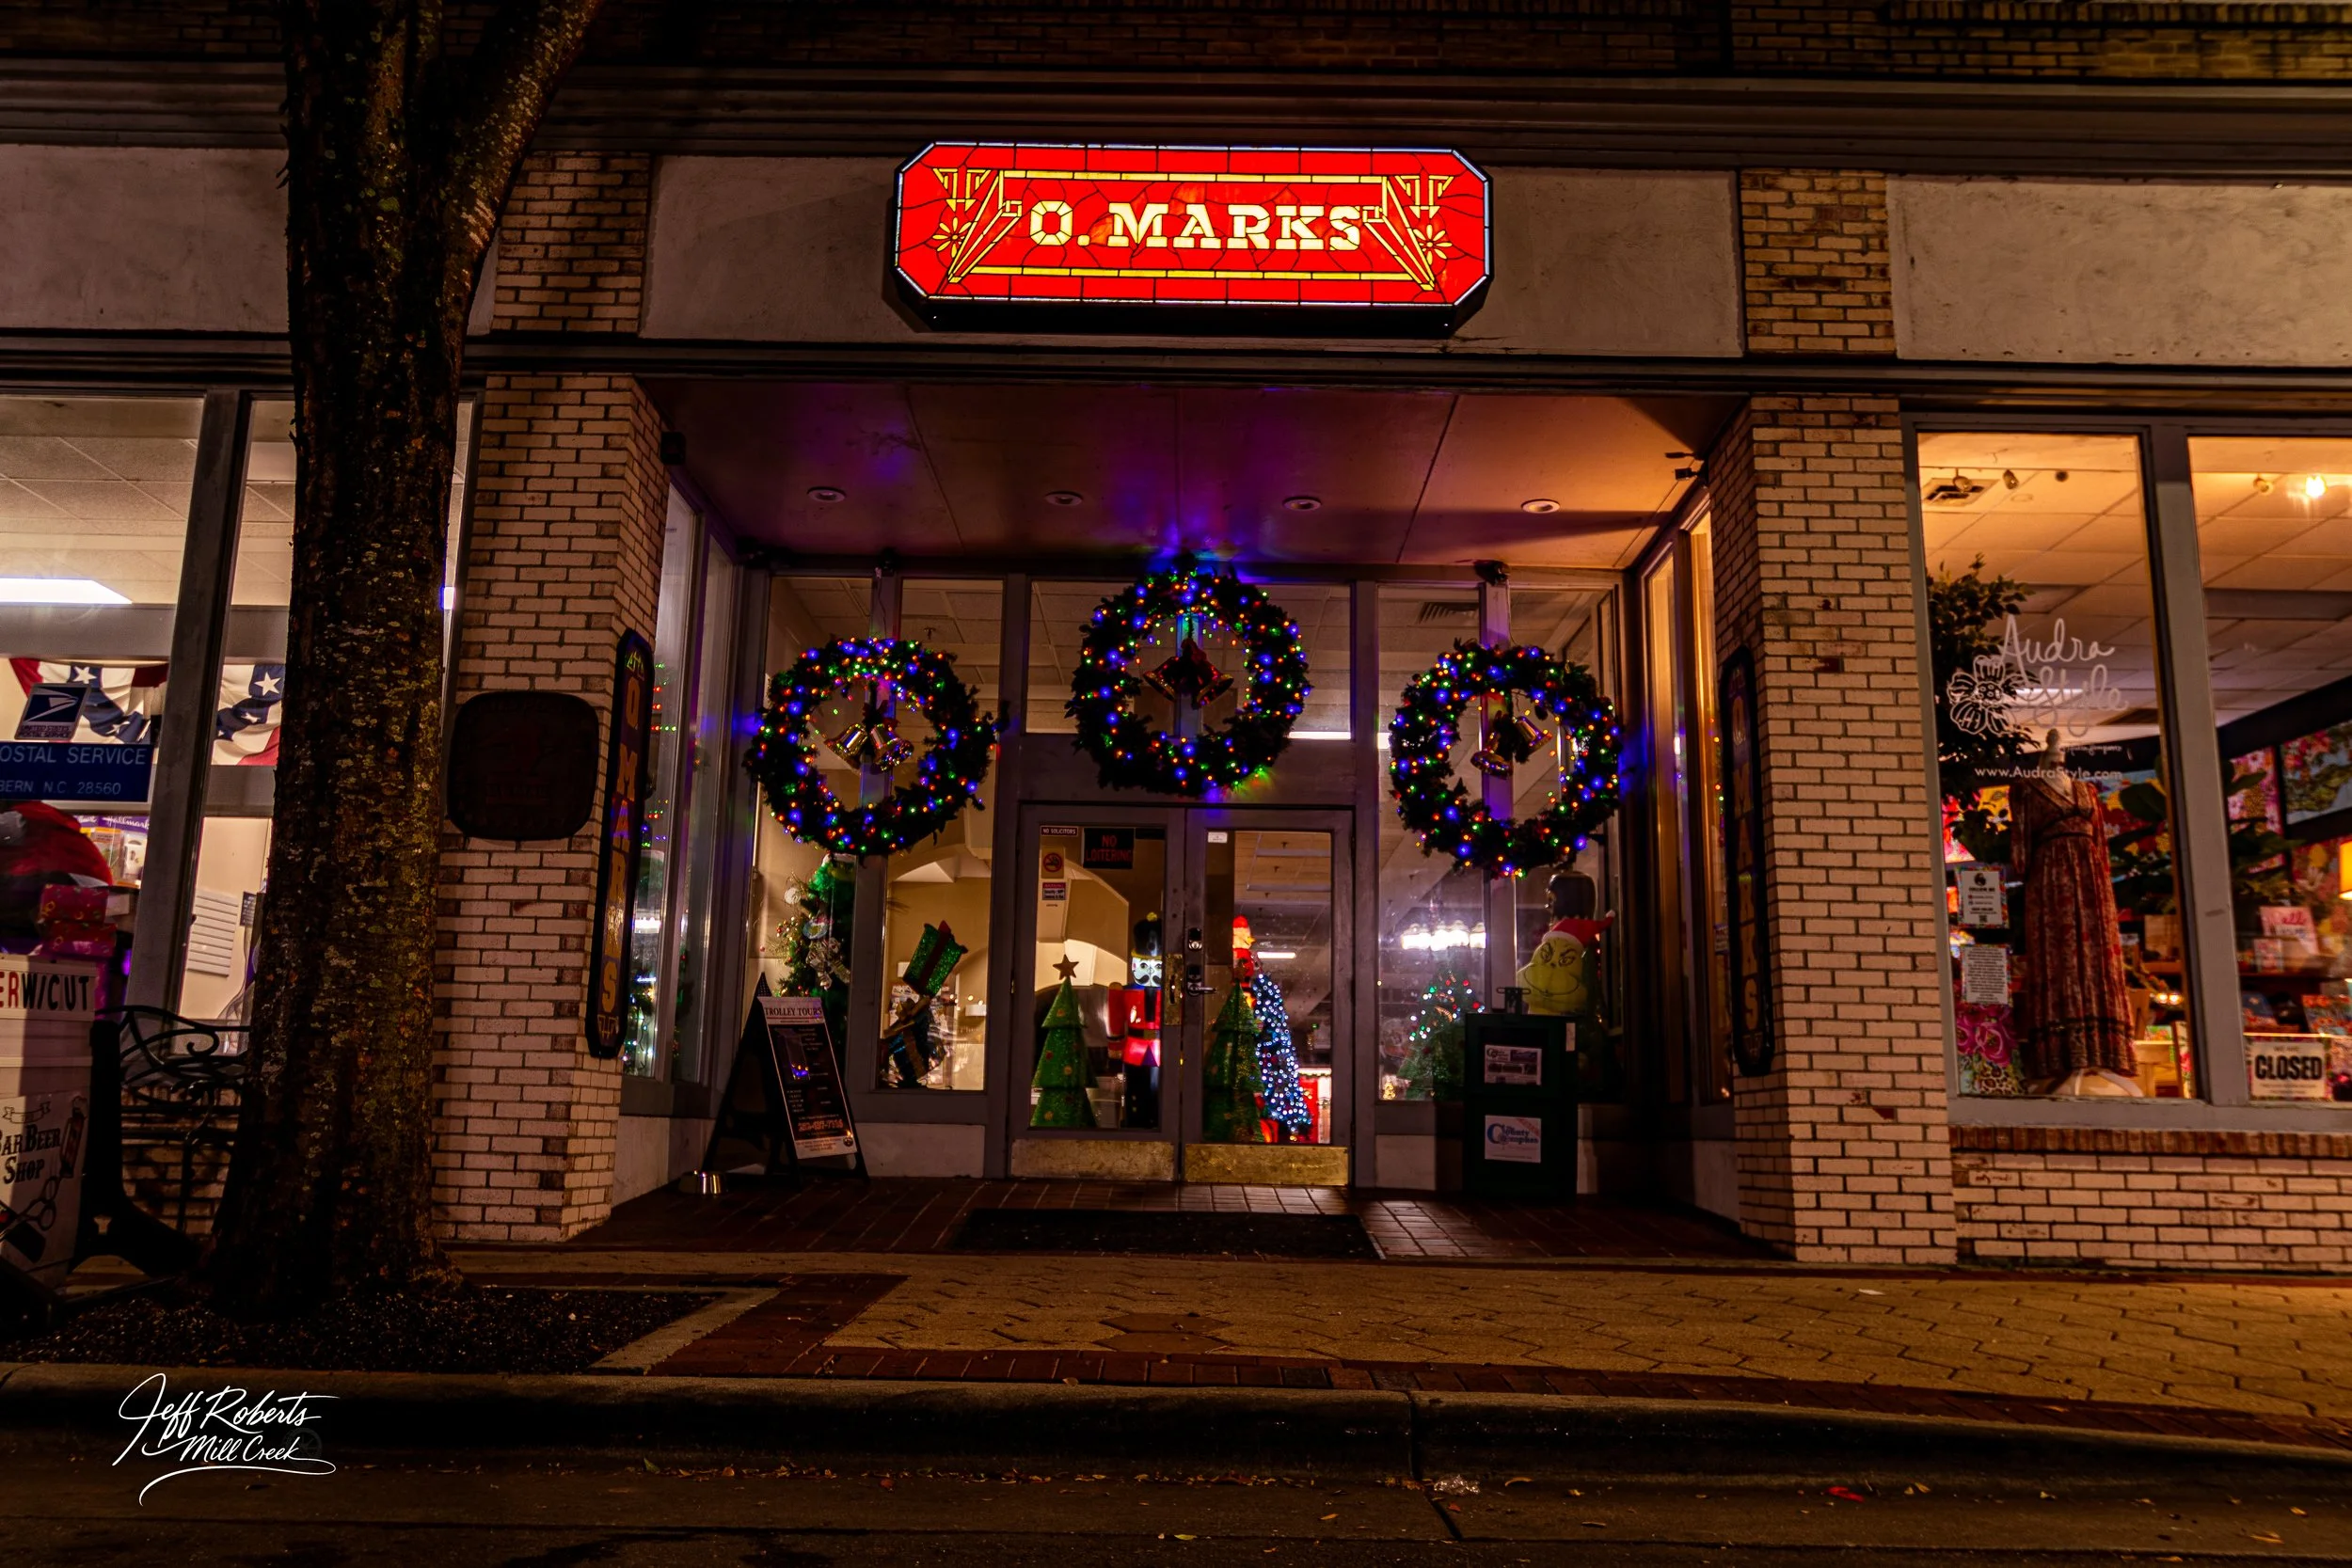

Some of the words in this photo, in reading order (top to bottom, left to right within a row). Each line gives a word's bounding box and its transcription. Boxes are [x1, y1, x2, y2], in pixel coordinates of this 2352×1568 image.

[1029, 200, 1090, 246] O.
[1107, 202, 1362, 251] MARKS
[1996, 614, 2115, 679] Audra
[2016, 664, 2129, 737] Style
[66, 747, 148, 766] SERVICE
[1975, 766, 2123, 781] www.AudraStyle.com
[76, 782, 121, 796] 28560
[1101, 834, 1118, 847] NO
[1086, 848, 1133, 862] LOITERING
[602, 742, 638, 1013] MARKS
[1733, 761, 1761, 1030] MARKS
[764, 1006, 795, 1016] TROLLEY
[797, 1006, 823, 1017] TOURS
[2254, 1055, 2323, 1080] CLOSED
